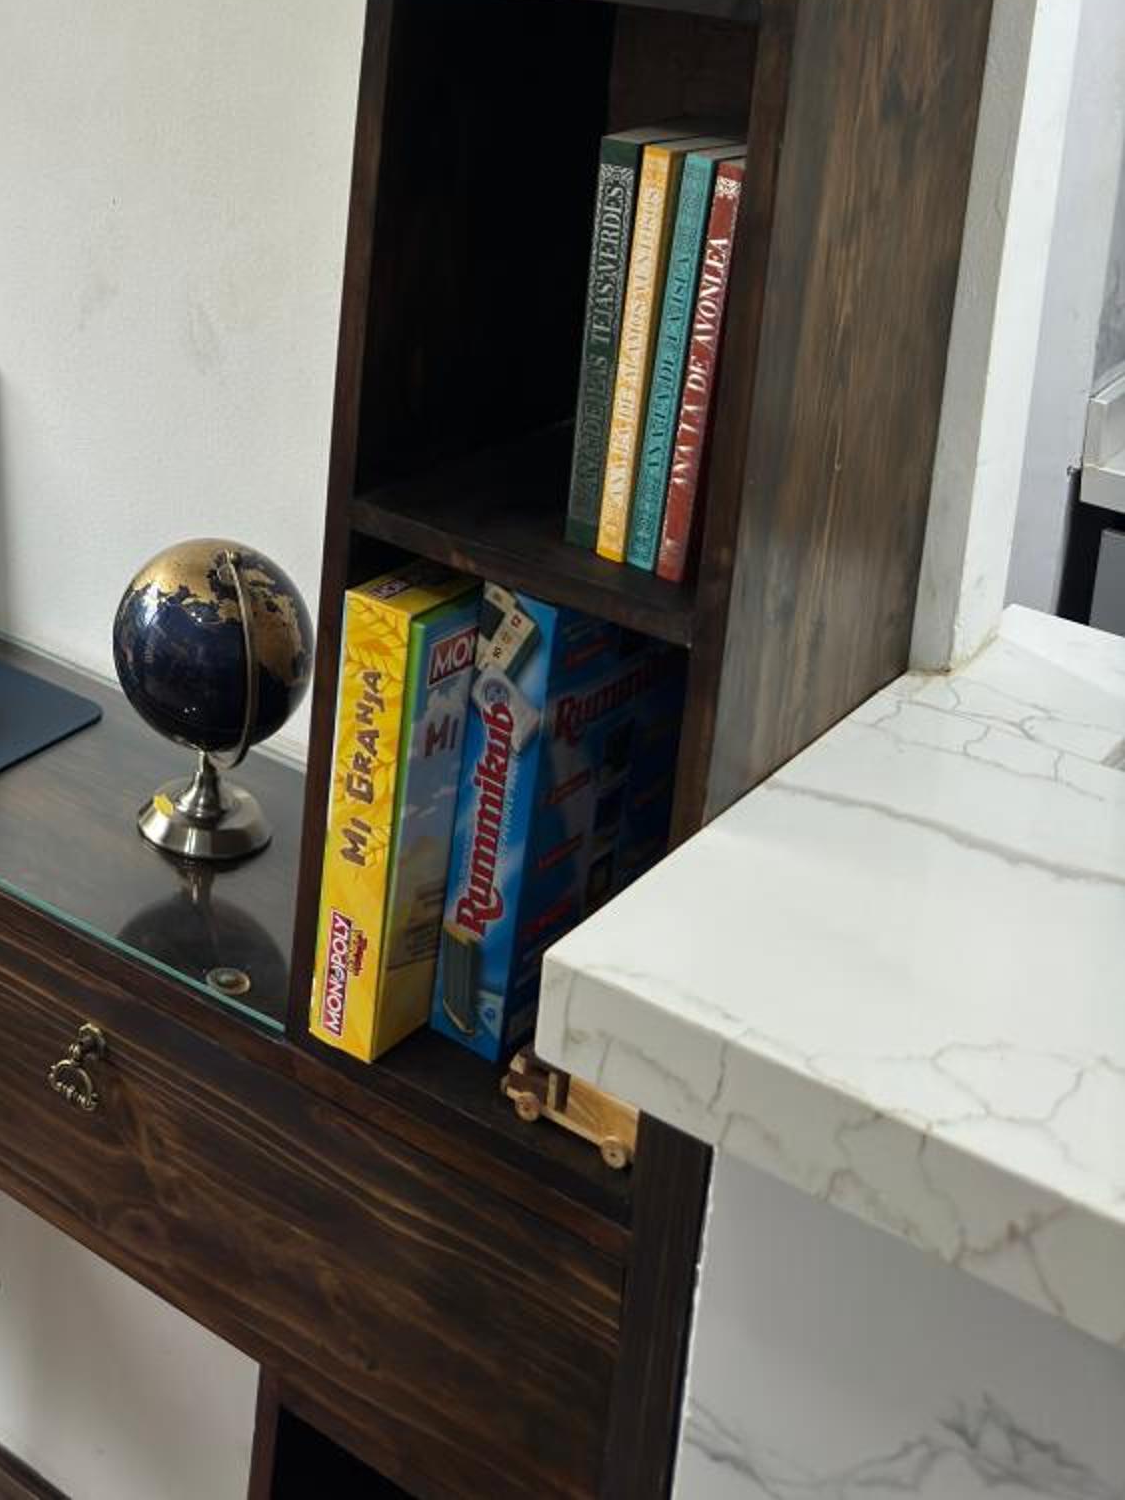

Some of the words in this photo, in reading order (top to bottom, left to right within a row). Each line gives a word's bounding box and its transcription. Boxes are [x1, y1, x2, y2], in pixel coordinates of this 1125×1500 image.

[597, 185, 625, 277] VERDES
[692, 237, 729, 350] AVONLEA
[687, 355, 709, 392] DE
[456, 702, 514, 937] Rummikub
[324, 914, 350, 1033] MONOPOLY
